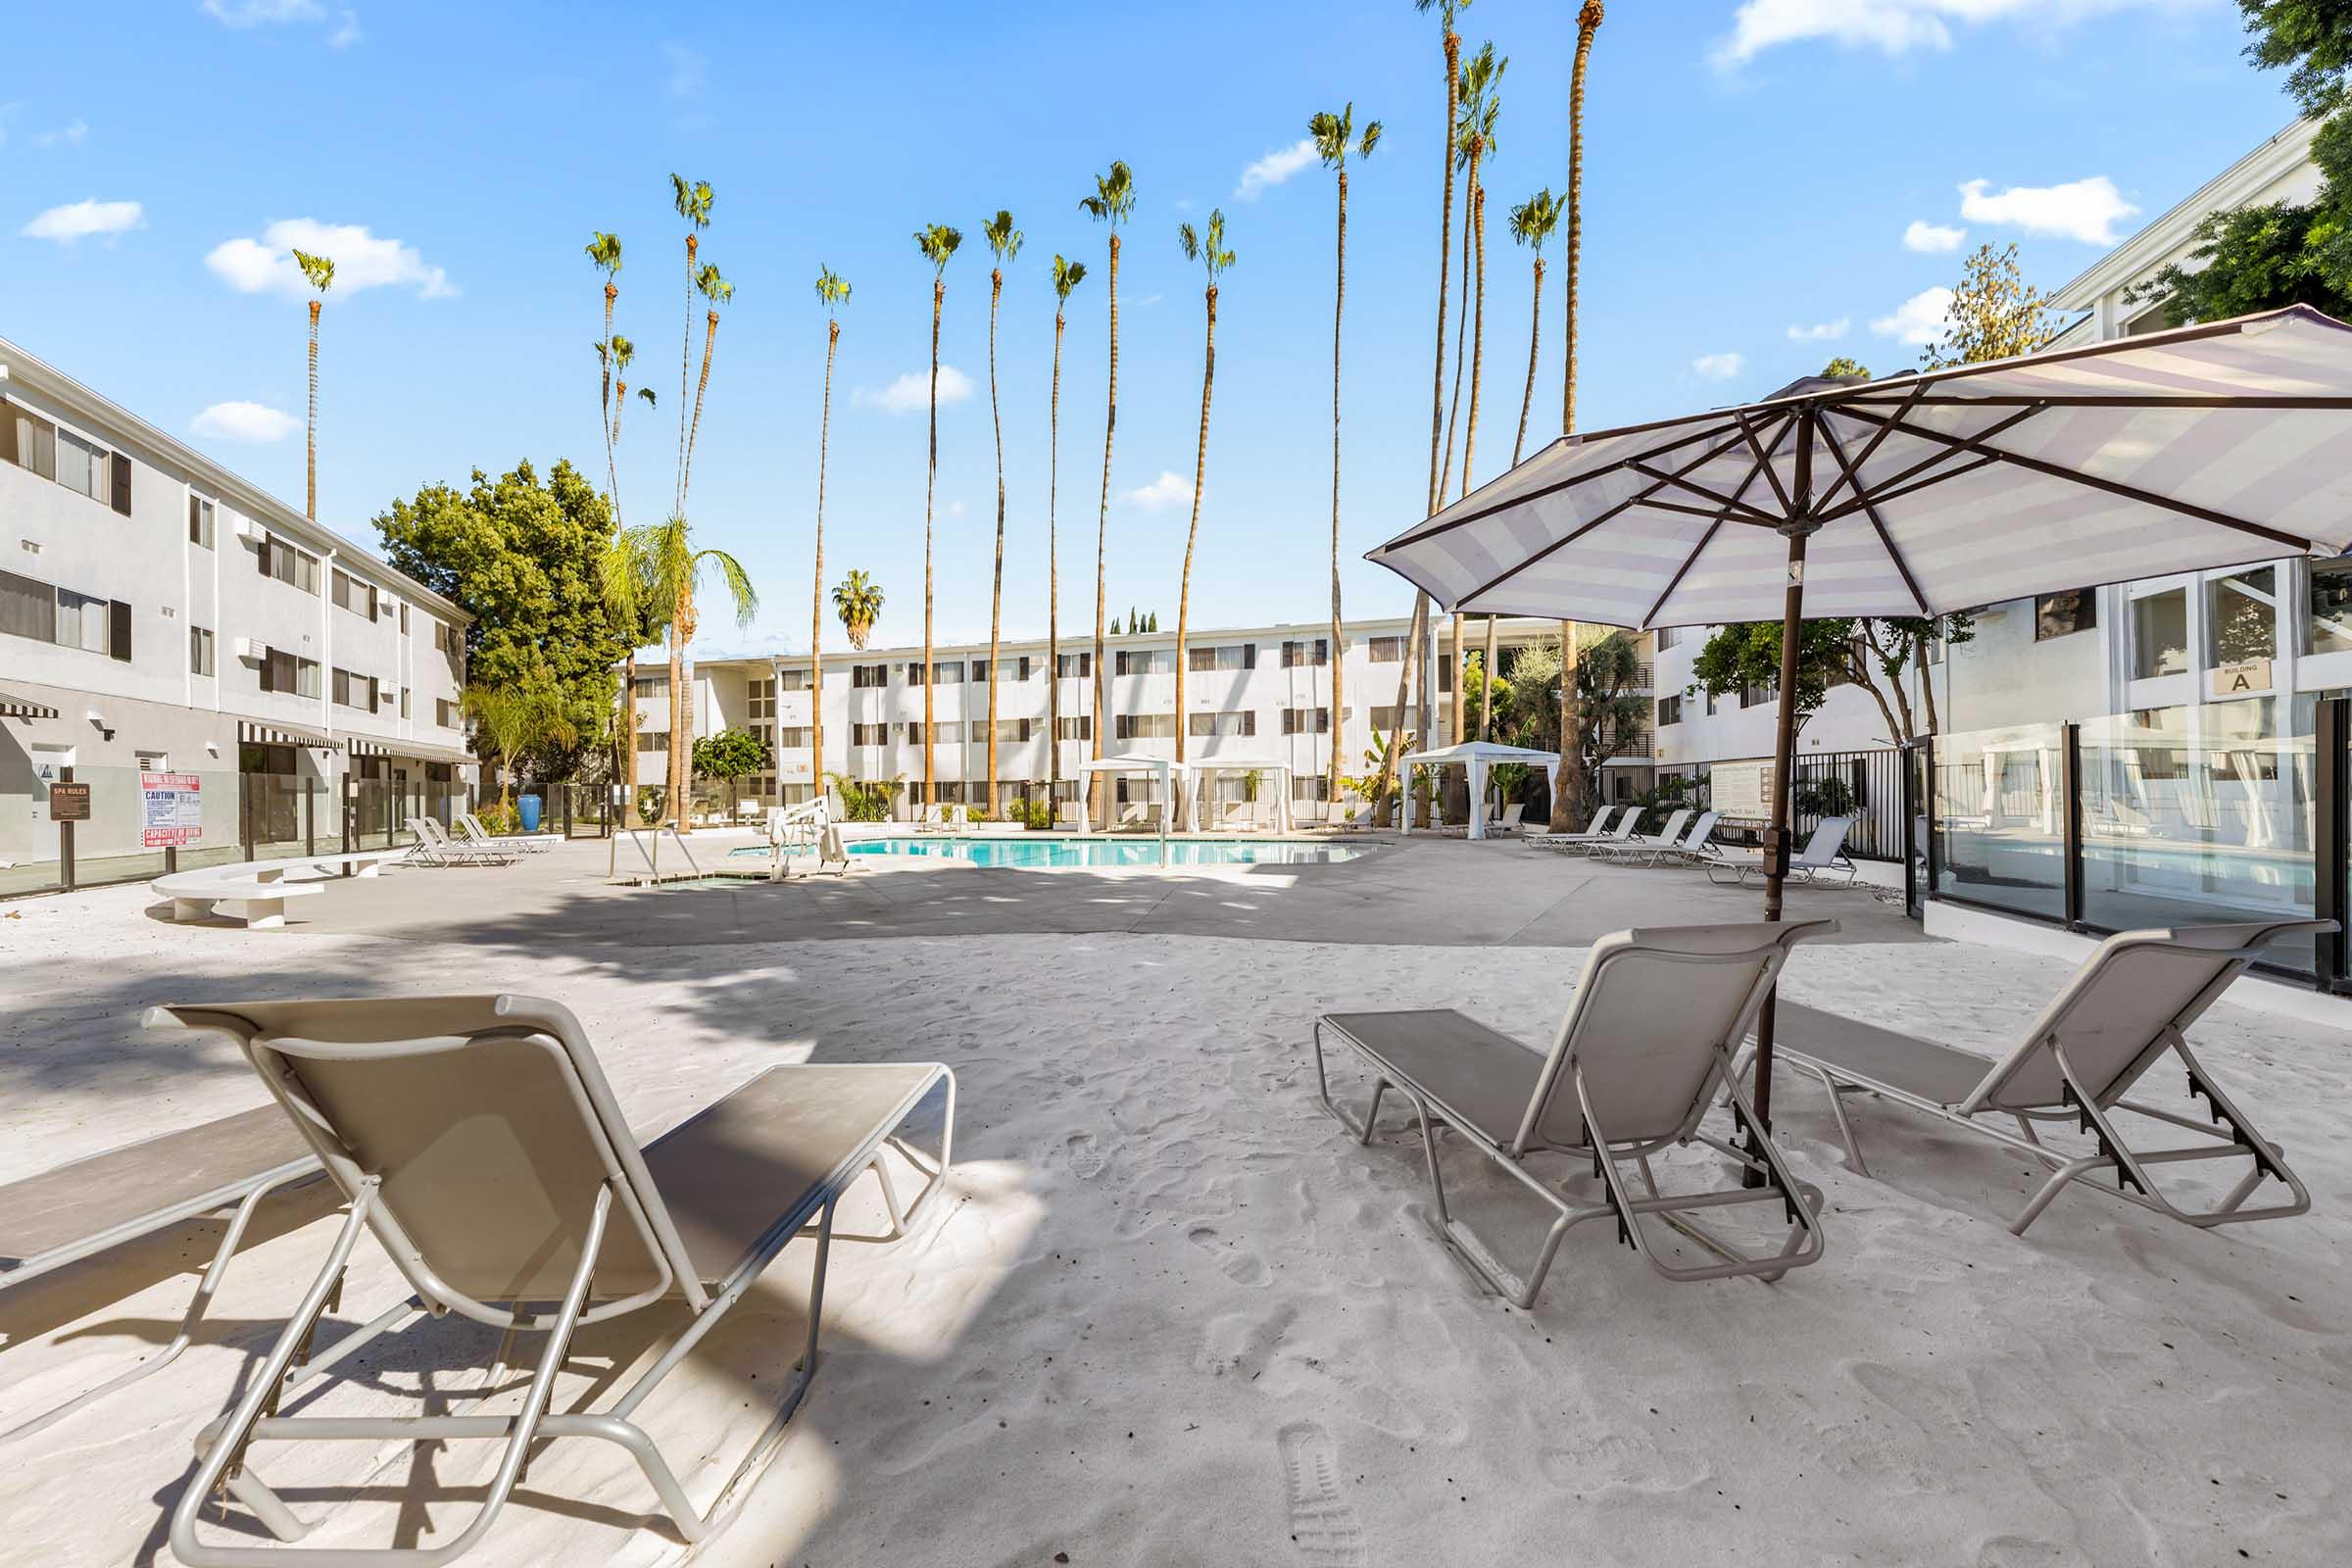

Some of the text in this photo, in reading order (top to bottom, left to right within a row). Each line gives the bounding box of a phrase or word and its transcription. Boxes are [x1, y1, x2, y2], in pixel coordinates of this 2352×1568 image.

[2225, 665, 2258, 674] BUILDING
[2231, 673, 2250, 691] A
[146, 791, 174, 800] CAUTION
[146, 829, 174, 839] CAPACITY
